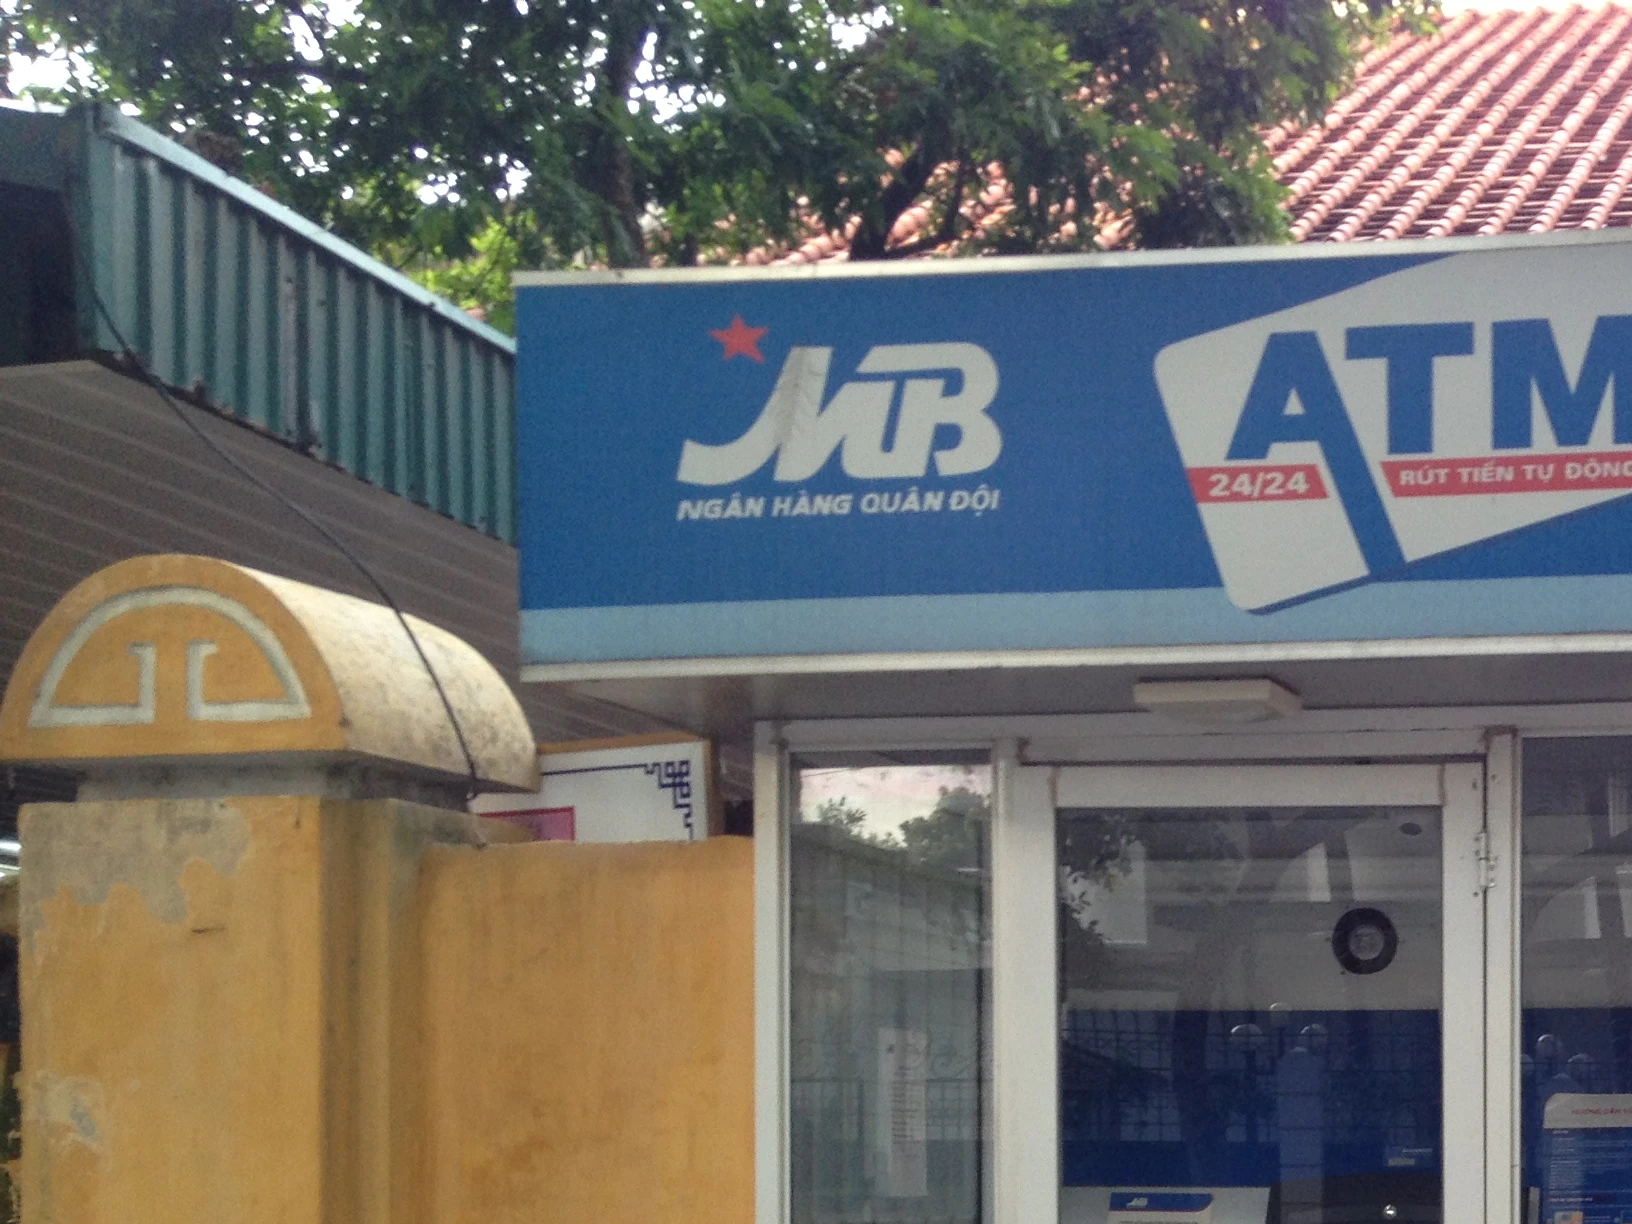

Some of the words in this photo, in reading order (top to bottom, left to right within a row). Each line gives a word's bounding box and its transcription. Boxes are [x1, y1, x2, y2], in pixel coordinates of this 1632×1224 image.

[676, 342, 1003, 486] MB
[1208, 470, 1309, 498] 24/24
[1399, 464, 1450, 486] RÚT
[676, 491, 766, 521] NGÂN
[772, 489, 853, 517] HÀNG
[860, 485, 945, 514] QUÂN
[949, 483, 1003, 517] ĐỘI
